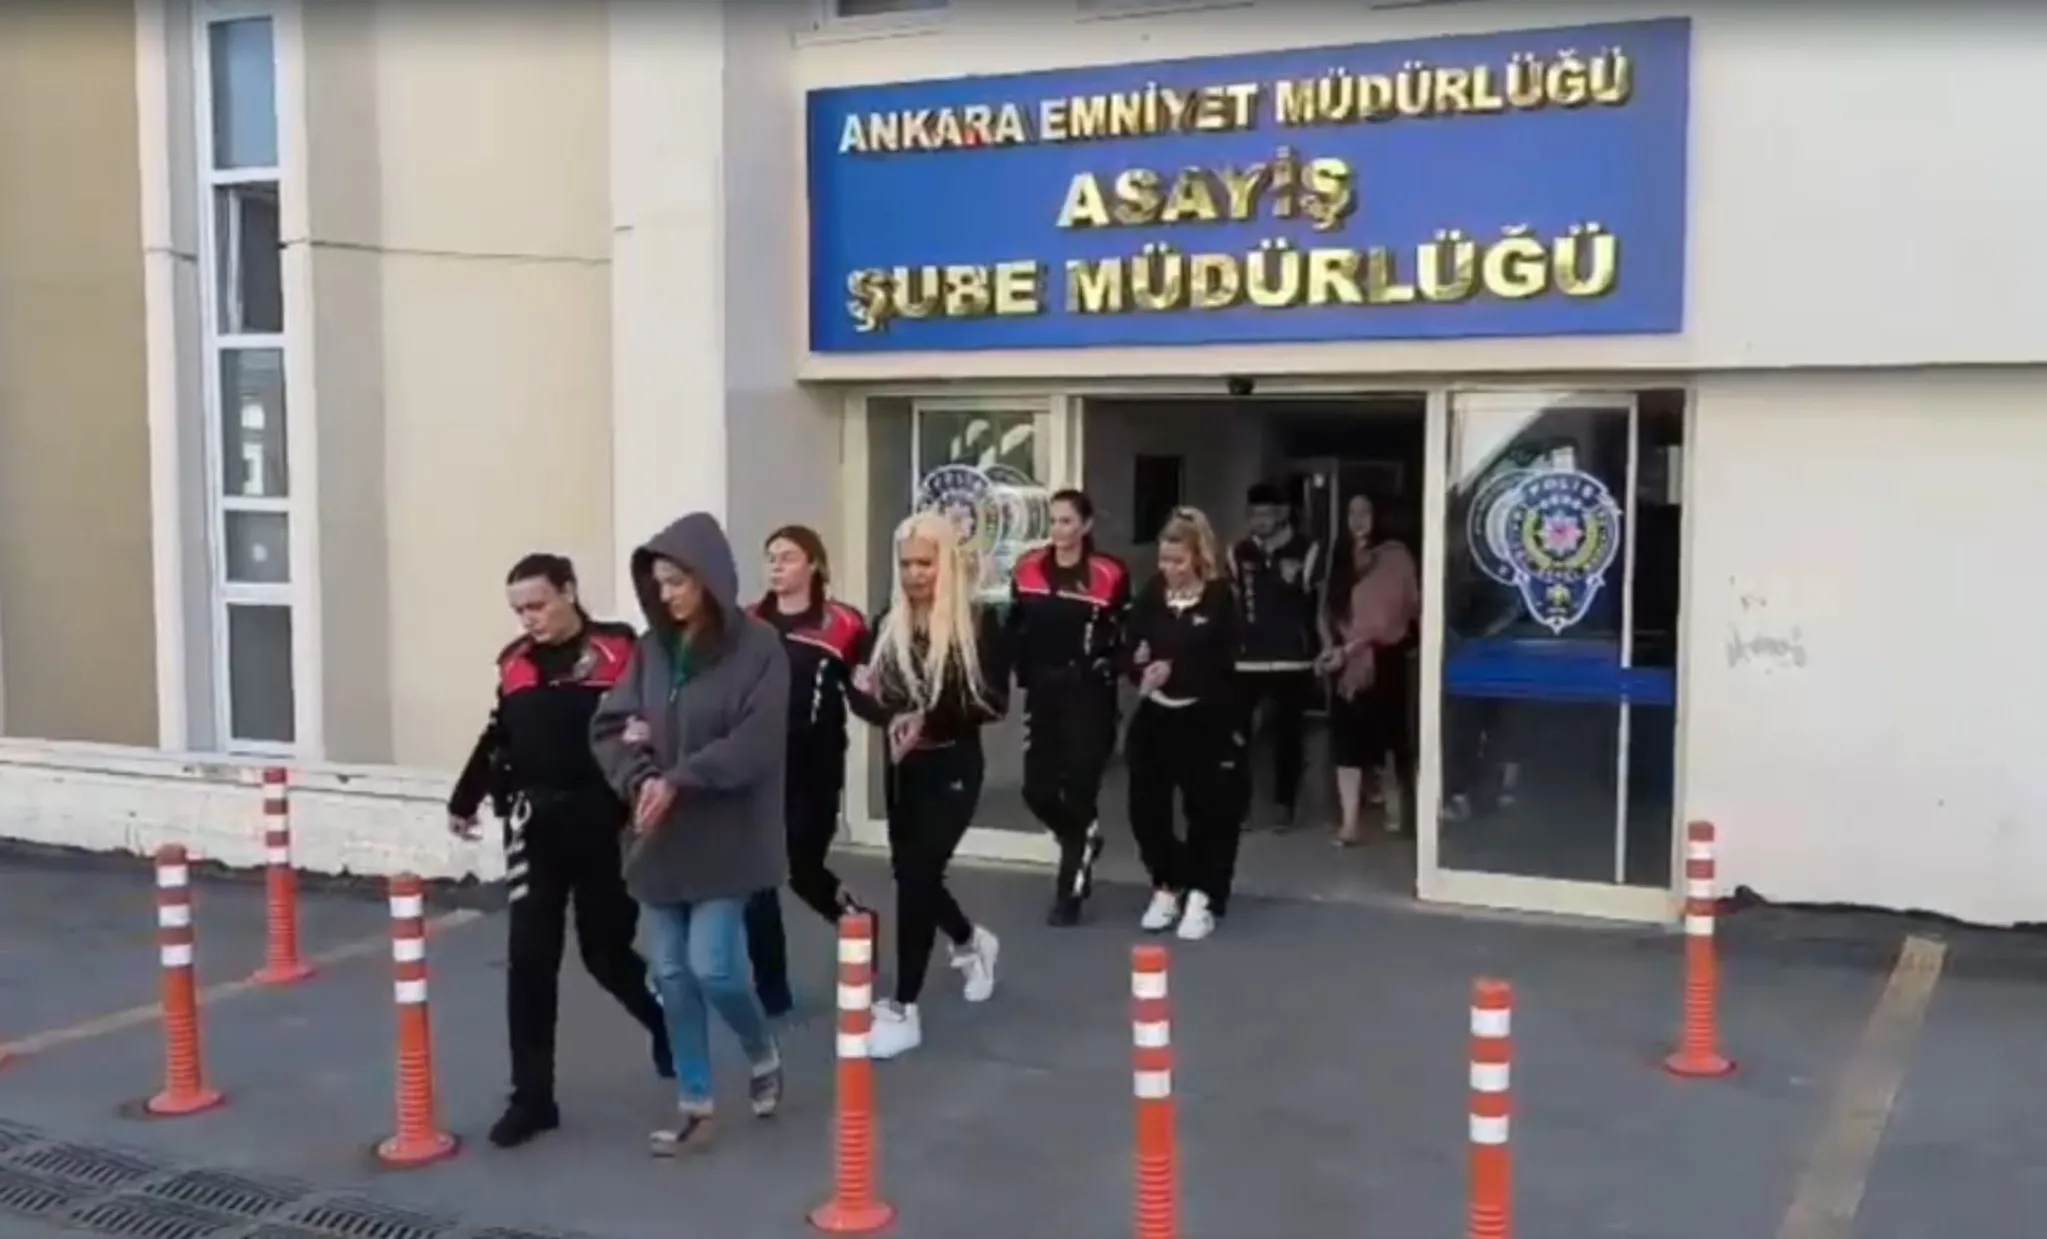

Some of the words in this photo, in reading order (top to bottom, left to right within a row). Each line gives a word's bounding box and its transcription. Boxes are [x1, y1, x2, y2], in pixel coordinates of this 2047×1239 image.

[837, 102, 1024, 153] ANKARA
[1040, 80, 1258, 140] EMNİYET
[1275, 46, 1630, 124] MÜDÜRLÜĞÜ
[1055, 145, 1351, 230] ASAYİŞ
[846, 258, 1038, 332] ŞUBE
[1065, 221, 1616, 312] MÜDÜRLÜĞÜ
